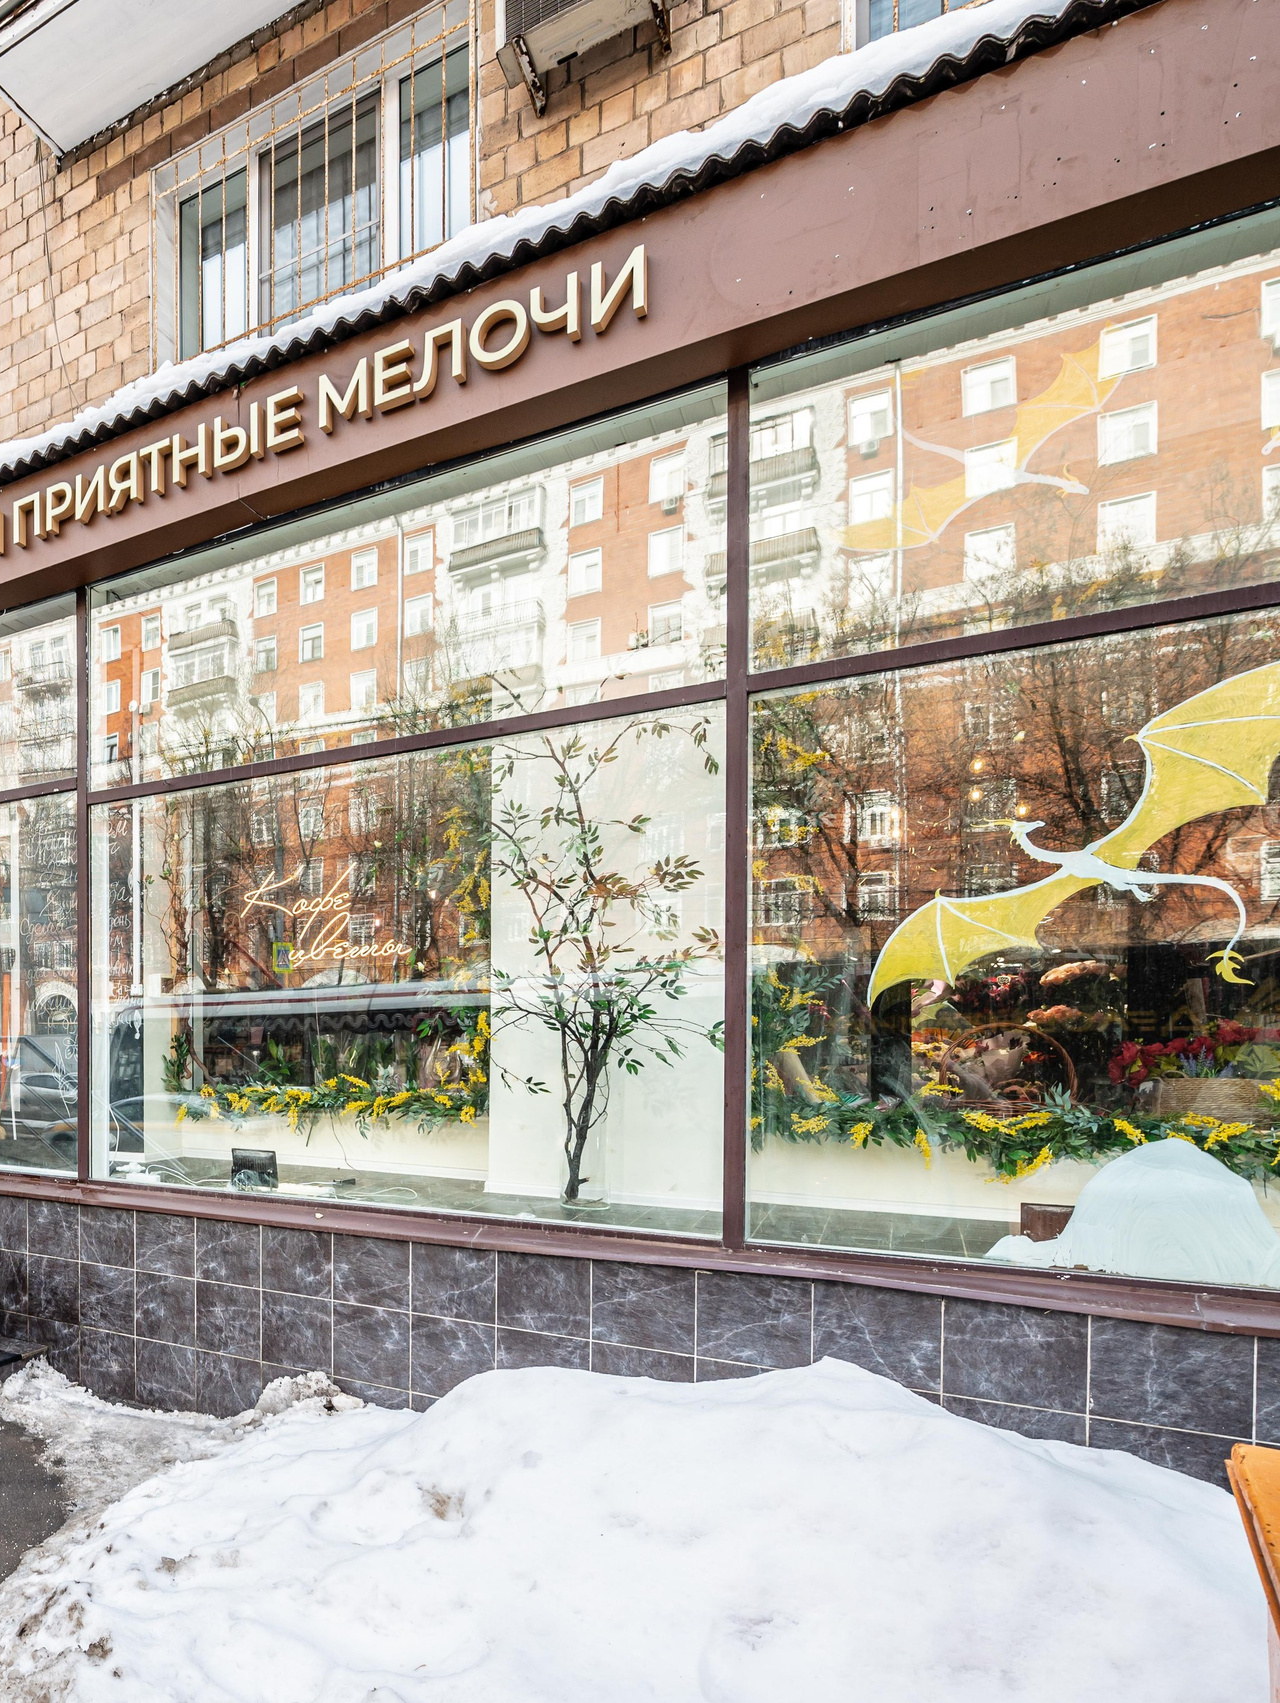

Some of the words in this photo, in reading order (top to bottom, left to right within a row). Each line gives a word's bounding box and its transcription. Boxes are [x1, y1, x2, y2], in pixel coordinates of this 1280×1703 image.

[13, 385, 305, 548] ПРИЯТНЫЕ
[318, 243, 648, 435] МЕЛОЧИ
[240, 861, 358, 941] Кофе
